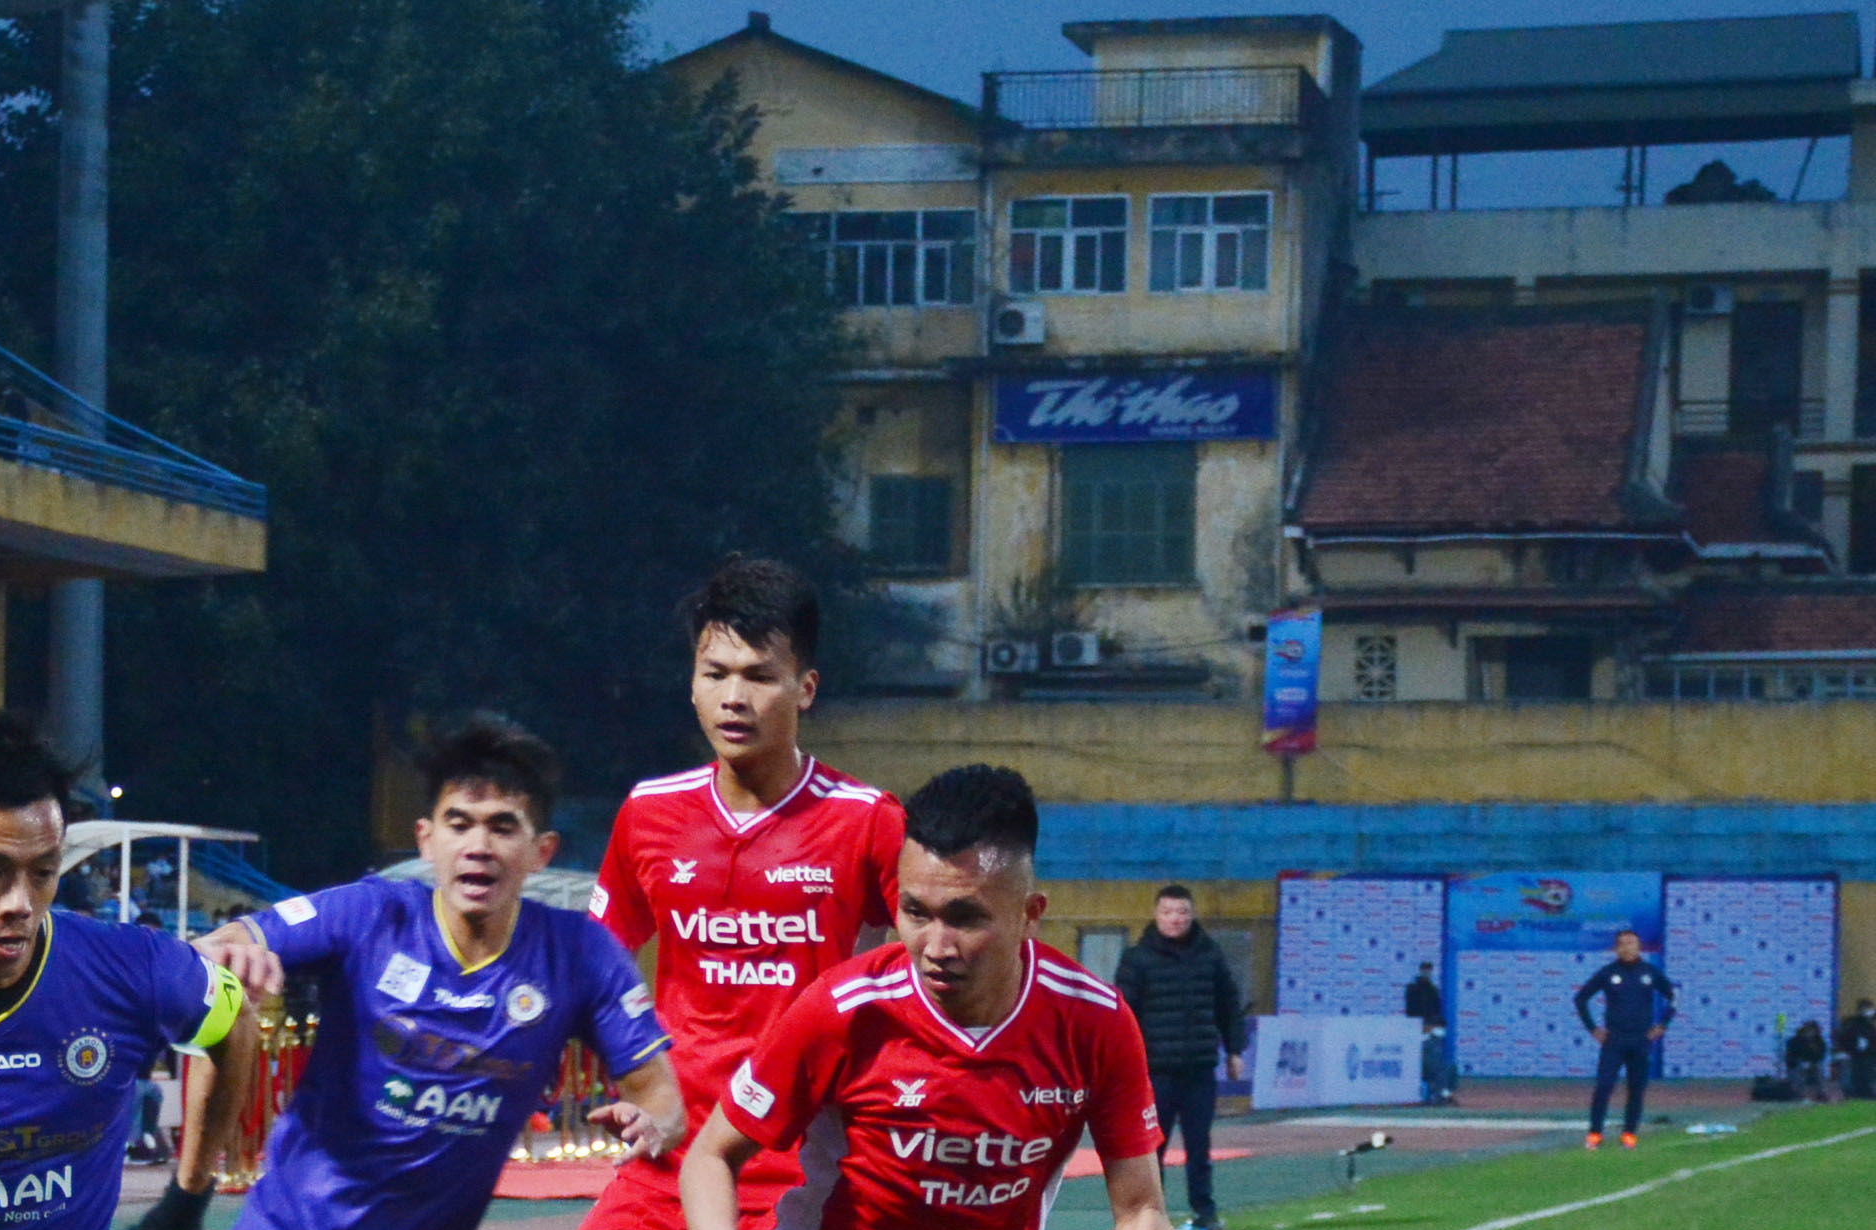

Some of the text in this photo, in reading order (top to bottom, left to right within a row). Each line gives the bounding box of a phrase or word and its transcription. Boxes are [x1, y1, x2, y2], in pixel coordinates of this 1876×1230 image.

[764, 866, 834, 884] viettel
[802, 884, 834, 894] sports
[670, 907, 826, 946] viettel
[699, 960, 796, 987] THACO
[888, 1127, 1053, 1168] viette
[919, 1177, 1031, 1206] THACO
